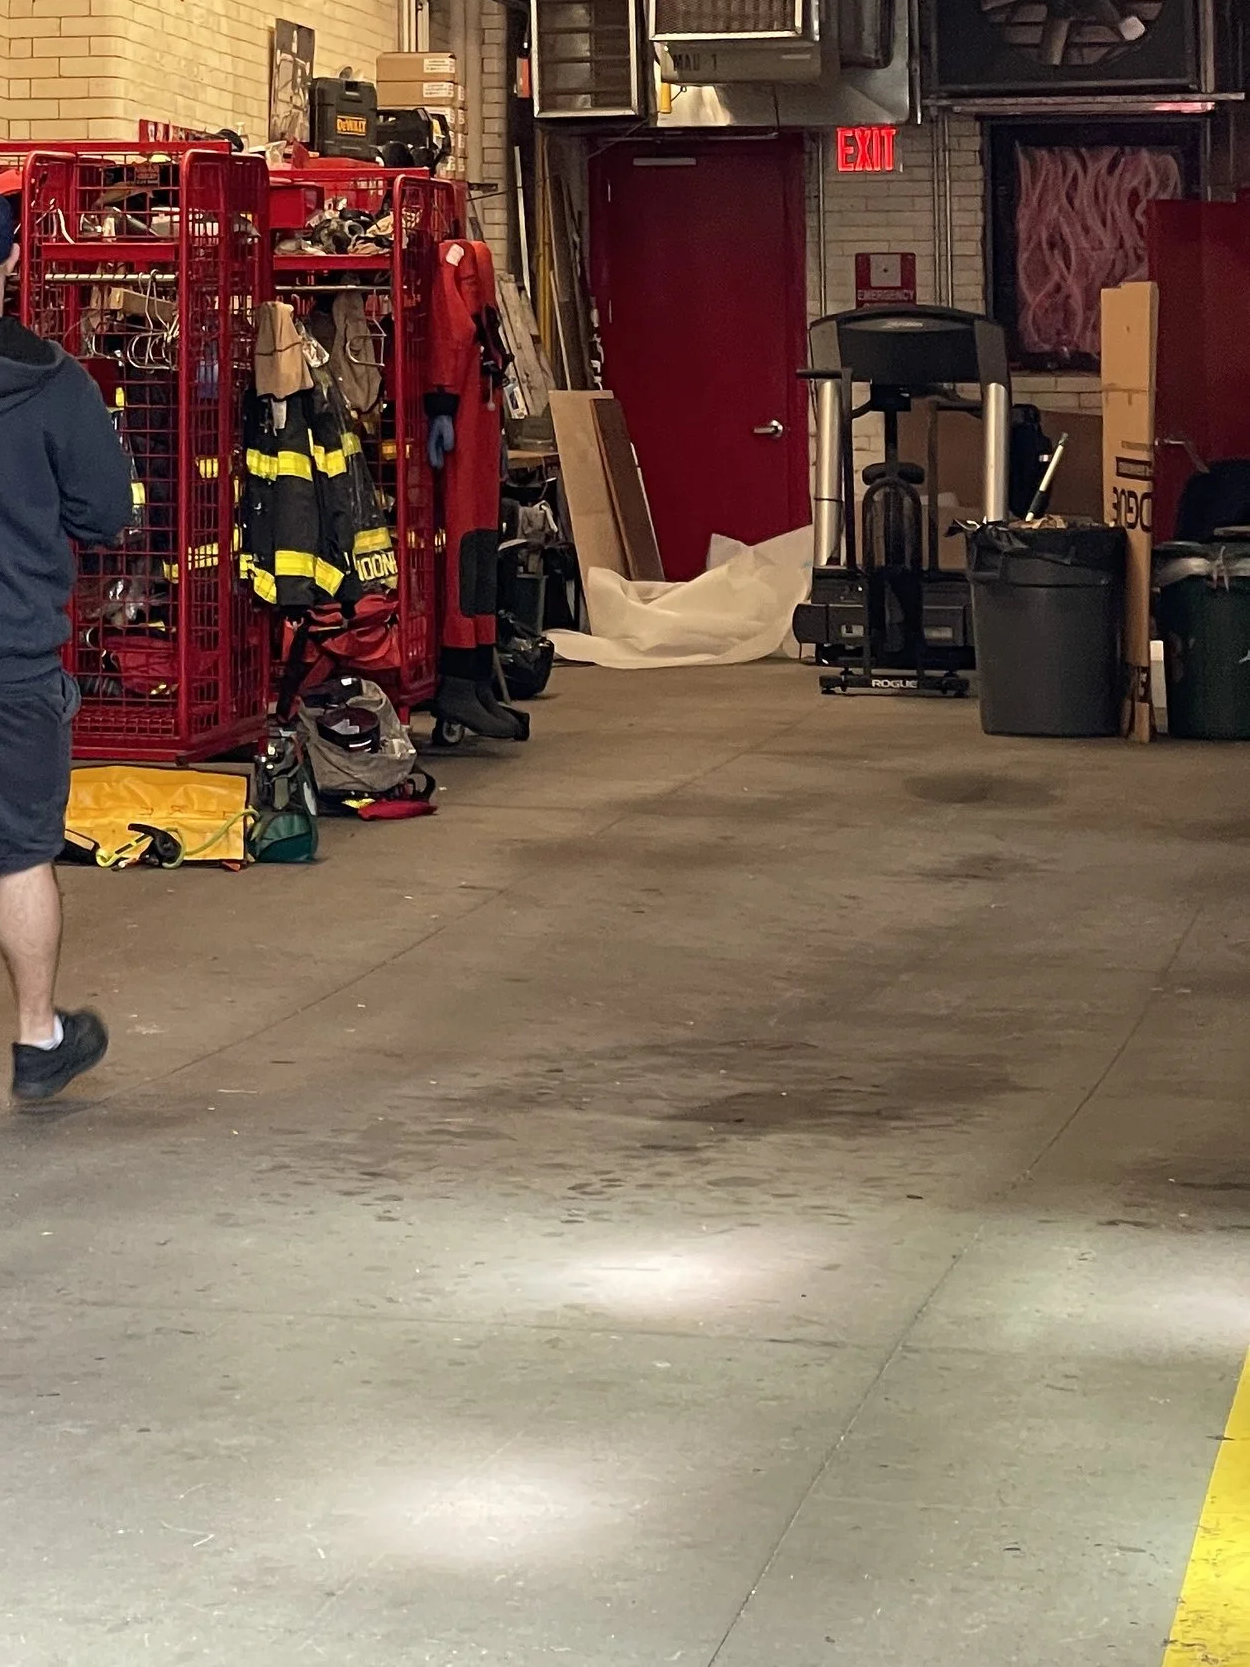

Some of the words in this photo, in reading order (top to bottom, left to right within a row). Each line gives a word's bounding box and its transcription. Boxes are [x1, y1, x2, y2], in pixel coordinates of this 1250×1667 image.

[836, 126, 897, 172] EXIT
[857, 289, 915, 301] EMERGENCY
[871, 679, 918, 689] ROGUE
